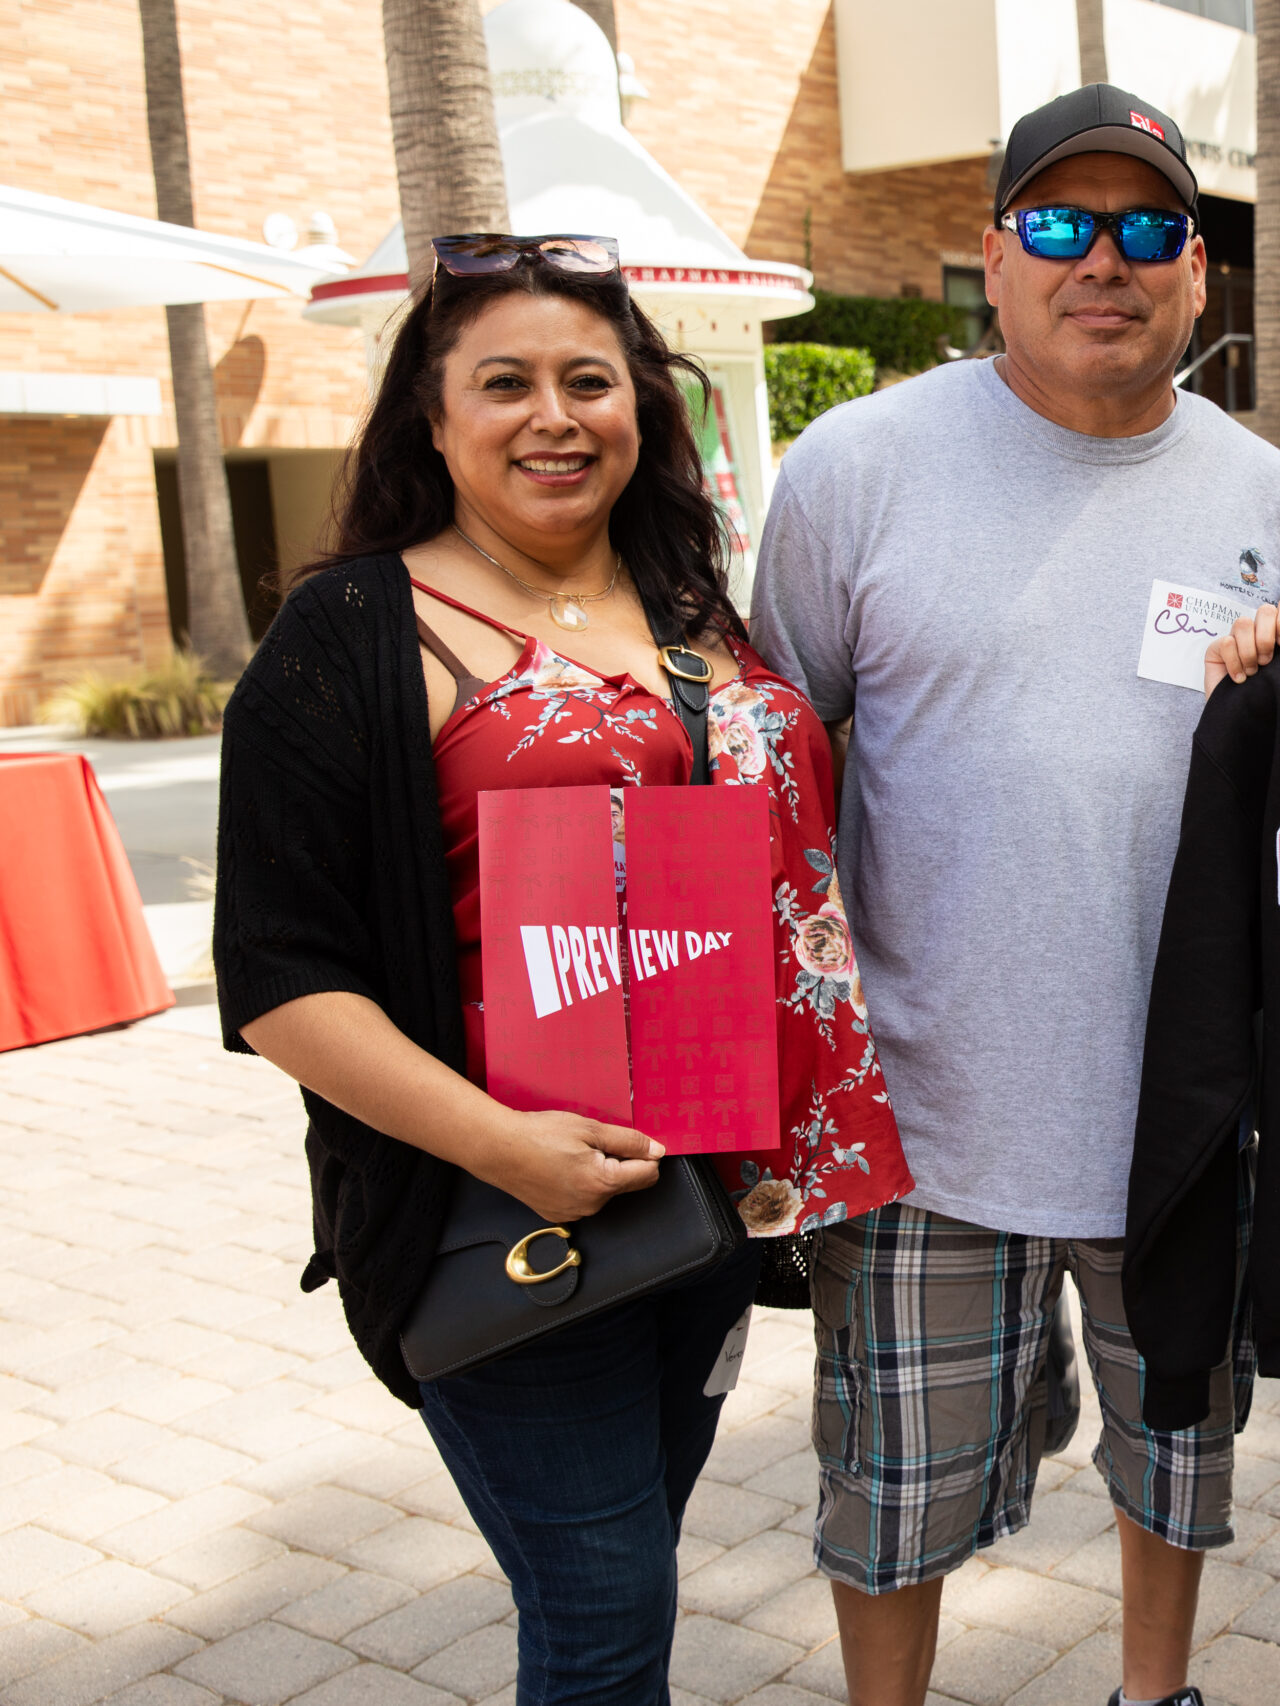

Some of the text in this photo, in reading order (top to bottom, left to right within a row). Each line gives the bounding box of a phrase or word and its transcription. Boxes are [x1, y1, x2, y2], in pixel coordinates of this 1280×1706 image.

[624, 267, 730, 284] CHAPMAN
[1185, 596, 1241, 618] CHAPMAN
[1185, 604, 1233, 624] UNIVERSIT
[685, 931, 733, 960] DAY
